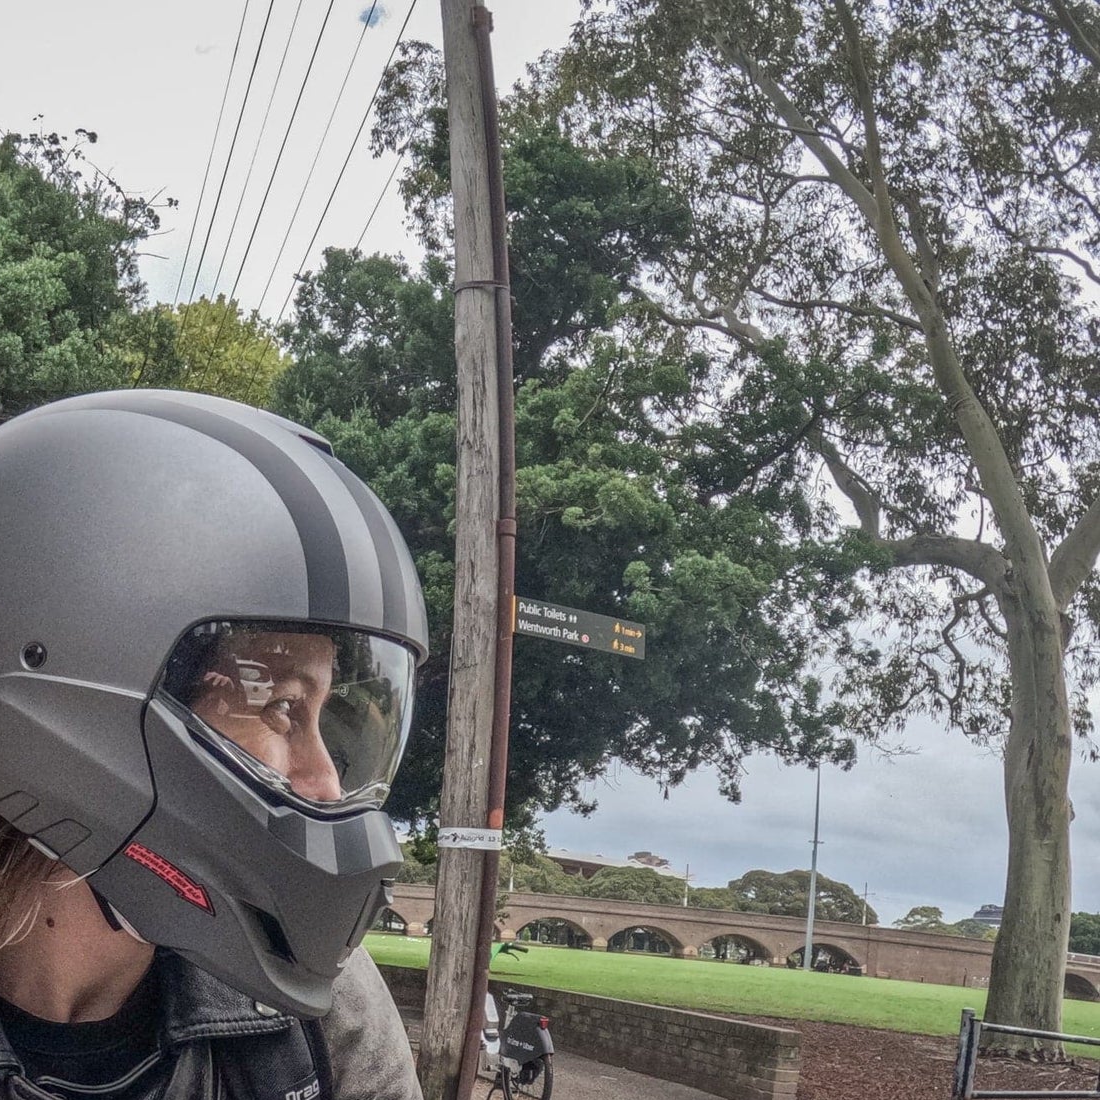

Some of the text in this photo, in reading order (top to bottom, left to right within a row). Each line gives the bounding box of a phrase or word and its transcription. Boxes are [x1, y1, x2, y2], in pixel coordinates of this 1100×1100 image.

[519, 602, 567, 622] Public Toilets
[518, 619, 580, 641] Wentworth Park
[624, 644, 636, 654] min
[129, 846, 172, 875] REMOVABLE
[171, 873, 189, 889] CHIN
